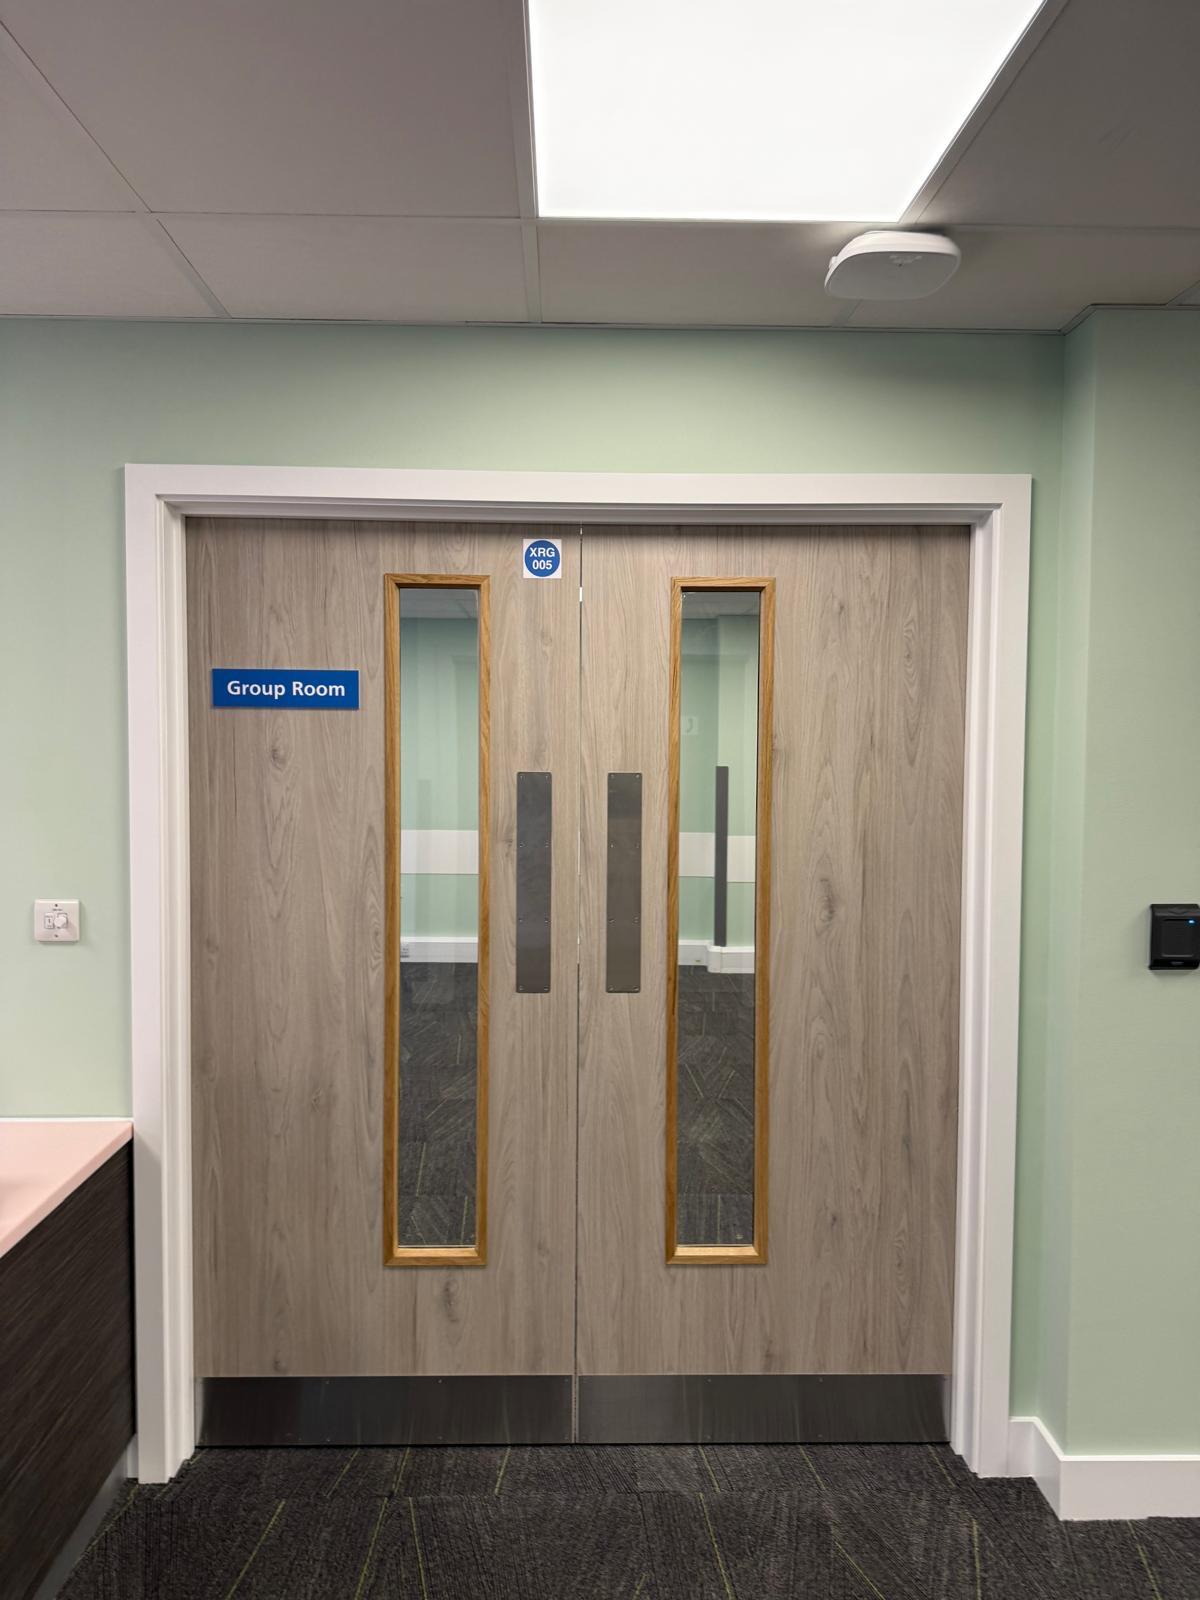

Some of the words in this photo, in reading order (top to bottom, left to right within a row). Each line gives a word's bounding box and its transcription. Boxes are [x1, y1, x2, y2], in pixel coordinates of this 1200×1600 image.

[530, 547, 556, 557] XRG
[532, 560, 552, 569] 005
[227, 681, 286, 700] Group
[292, 681, 346, 697] Room
